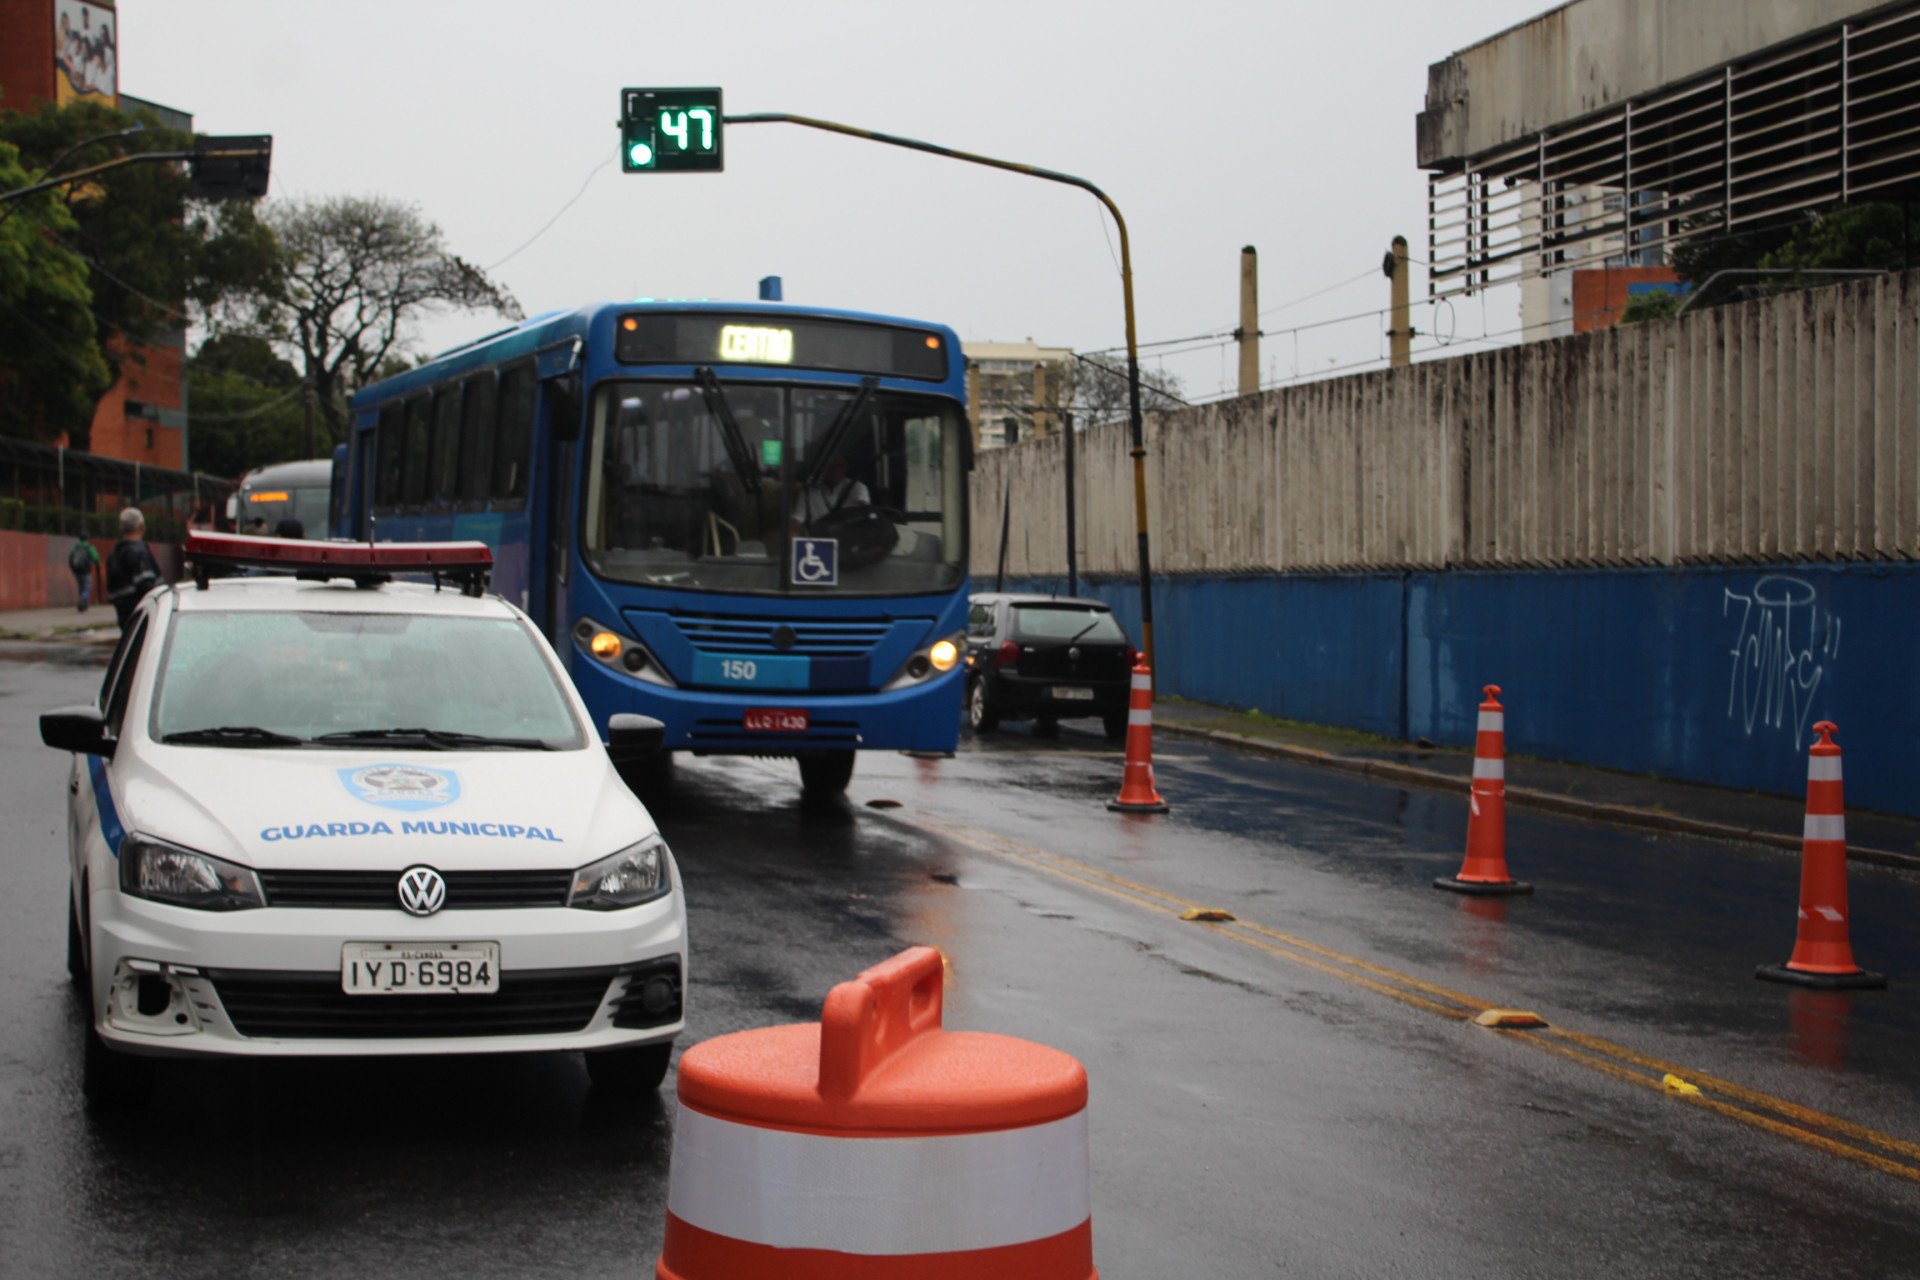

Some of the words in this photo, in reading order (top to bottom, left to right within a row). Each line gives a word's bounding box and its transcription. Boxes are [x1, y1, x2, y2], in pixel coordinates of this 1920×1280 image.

[661, 109, 713, 150] 47
[721, 660, 757, 680] 150
[259, 821, 394, 842] GUARDA
[401, 821, 564, 843] MUNICIPAL
